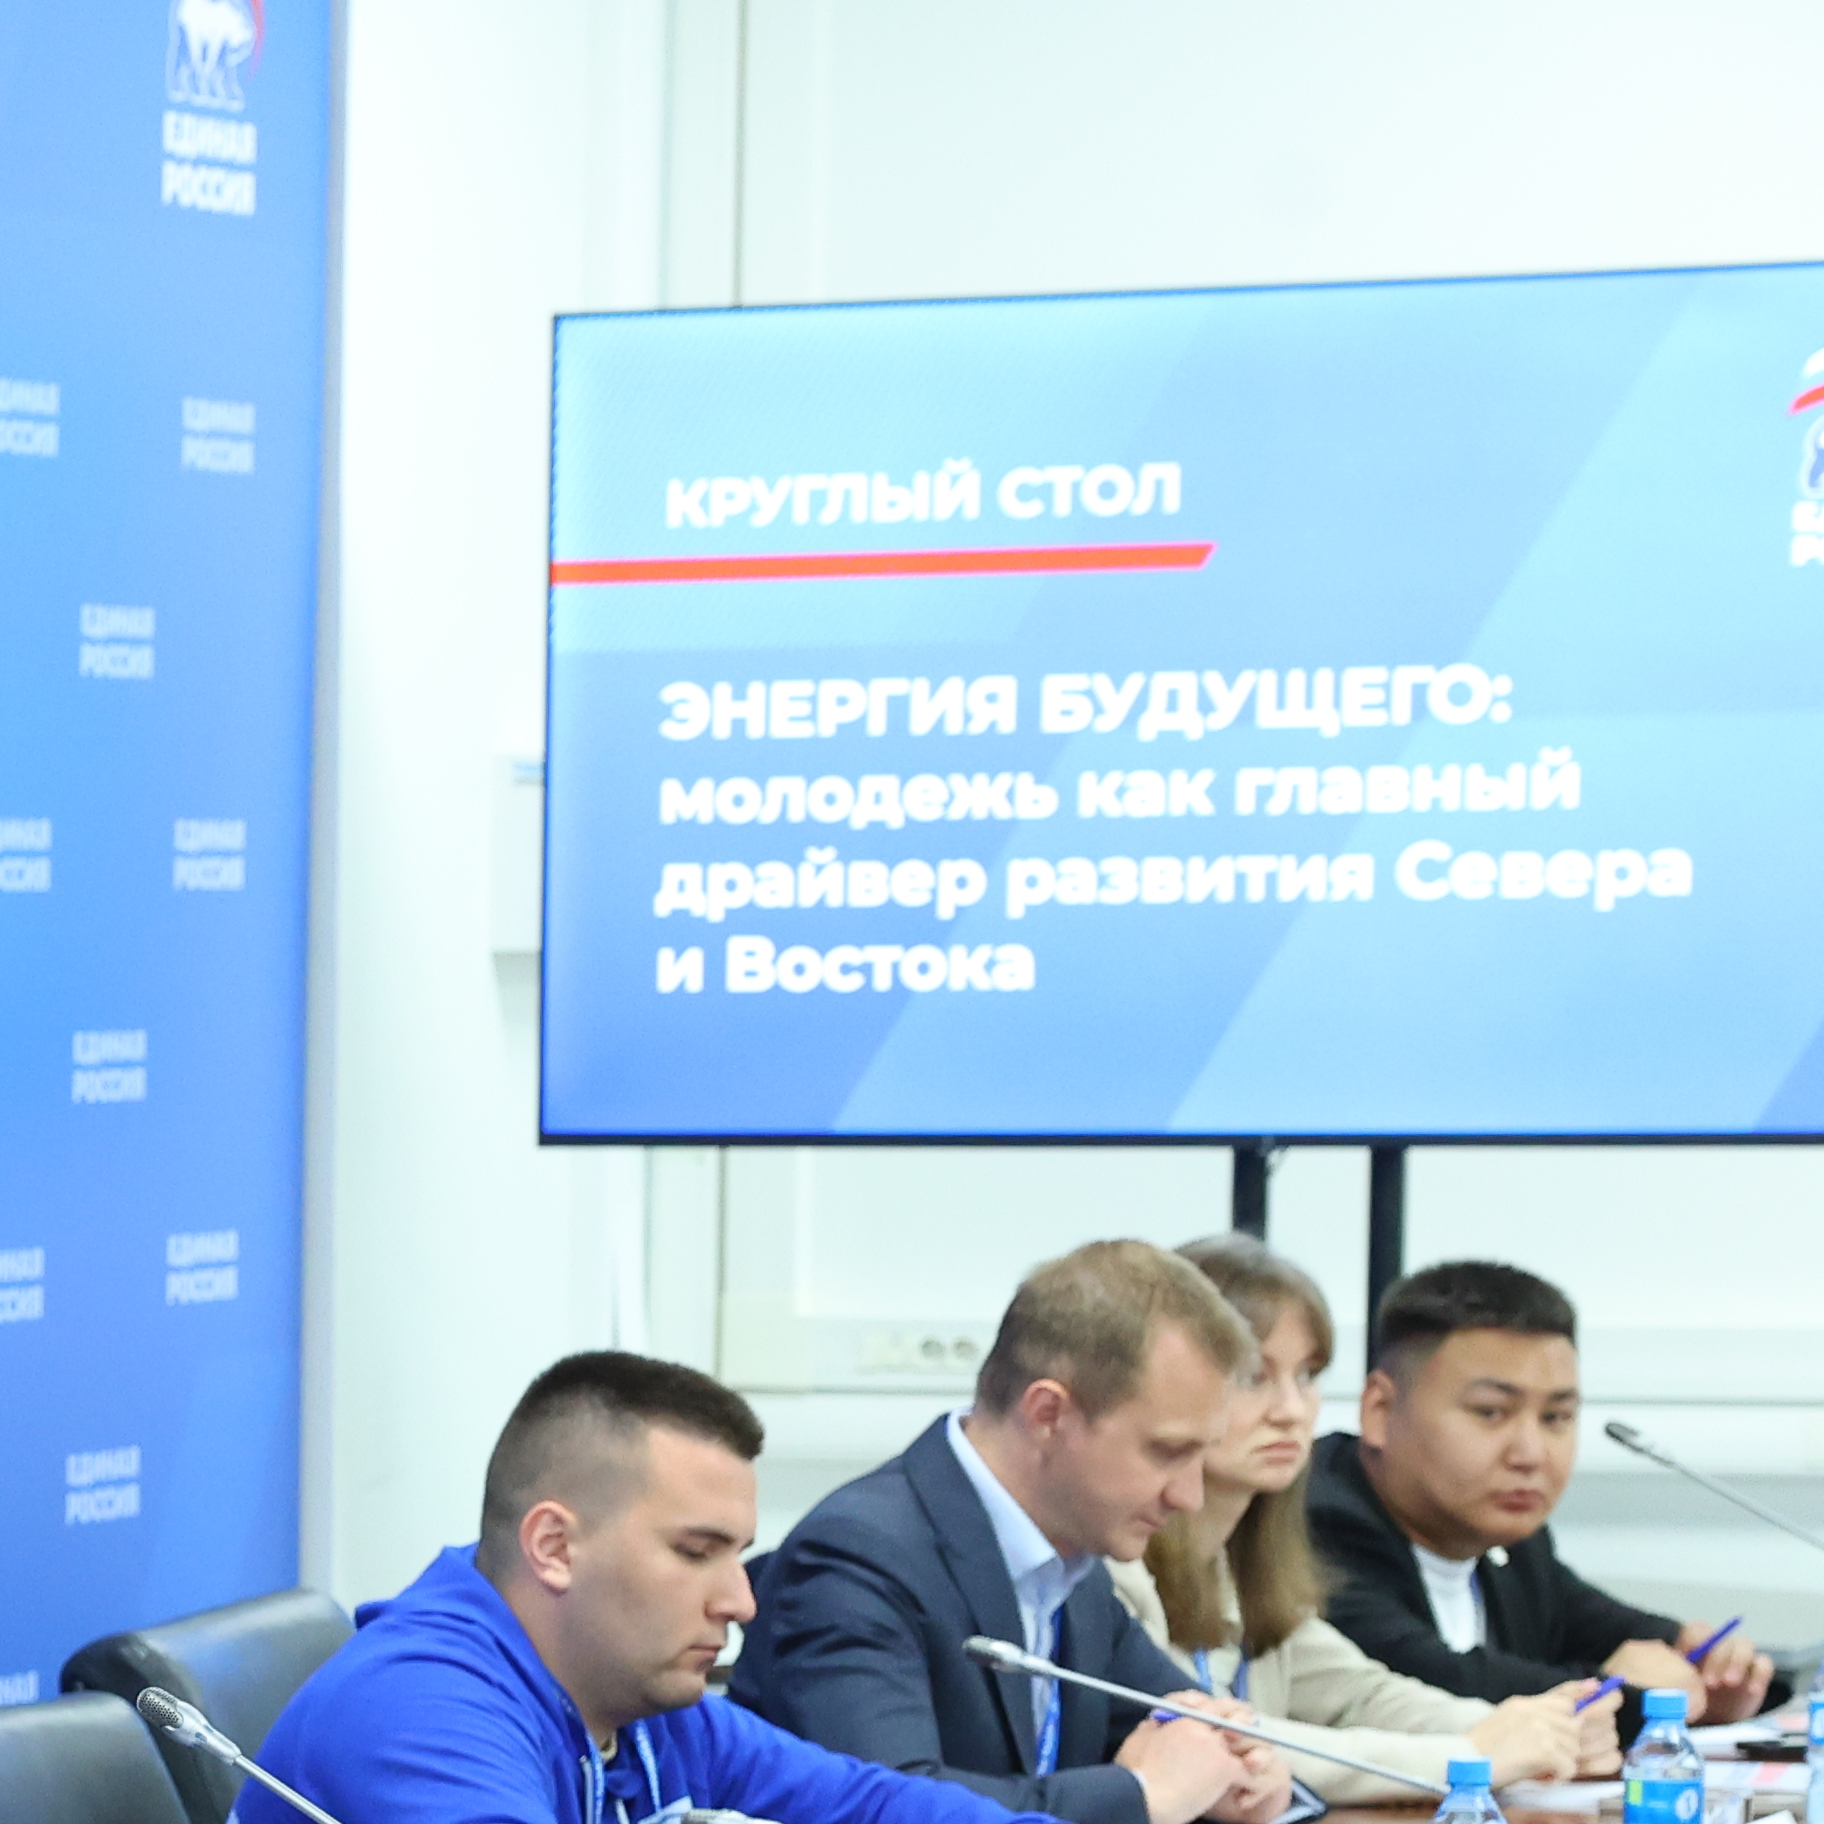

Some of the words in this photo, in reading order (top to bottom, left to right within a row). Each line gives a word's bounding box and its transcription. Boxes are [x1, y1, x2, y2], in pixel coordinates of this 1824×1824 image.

[667, 459, 980, 527] КРУГЛЫЙ
[998, 462, 1181, 518] СТОЛ
[660, 676, 1017, 740] ЭНЕРГИЯ
[1041, 664, 1512, 741] БУДУЩЕГО:
[660, 773, 1059, 827] молодежь
[1078, 769, 1215, 817] как
[1236, 747, 1581, 815] главный
[653, 849, 987, 922] драйвер
[1006, 854, 1374, 919] развития
[1396, 840, 1692, 912] Севера
[656, 947, 704, 994] и
[725, 935, 1036, 993] Востока
